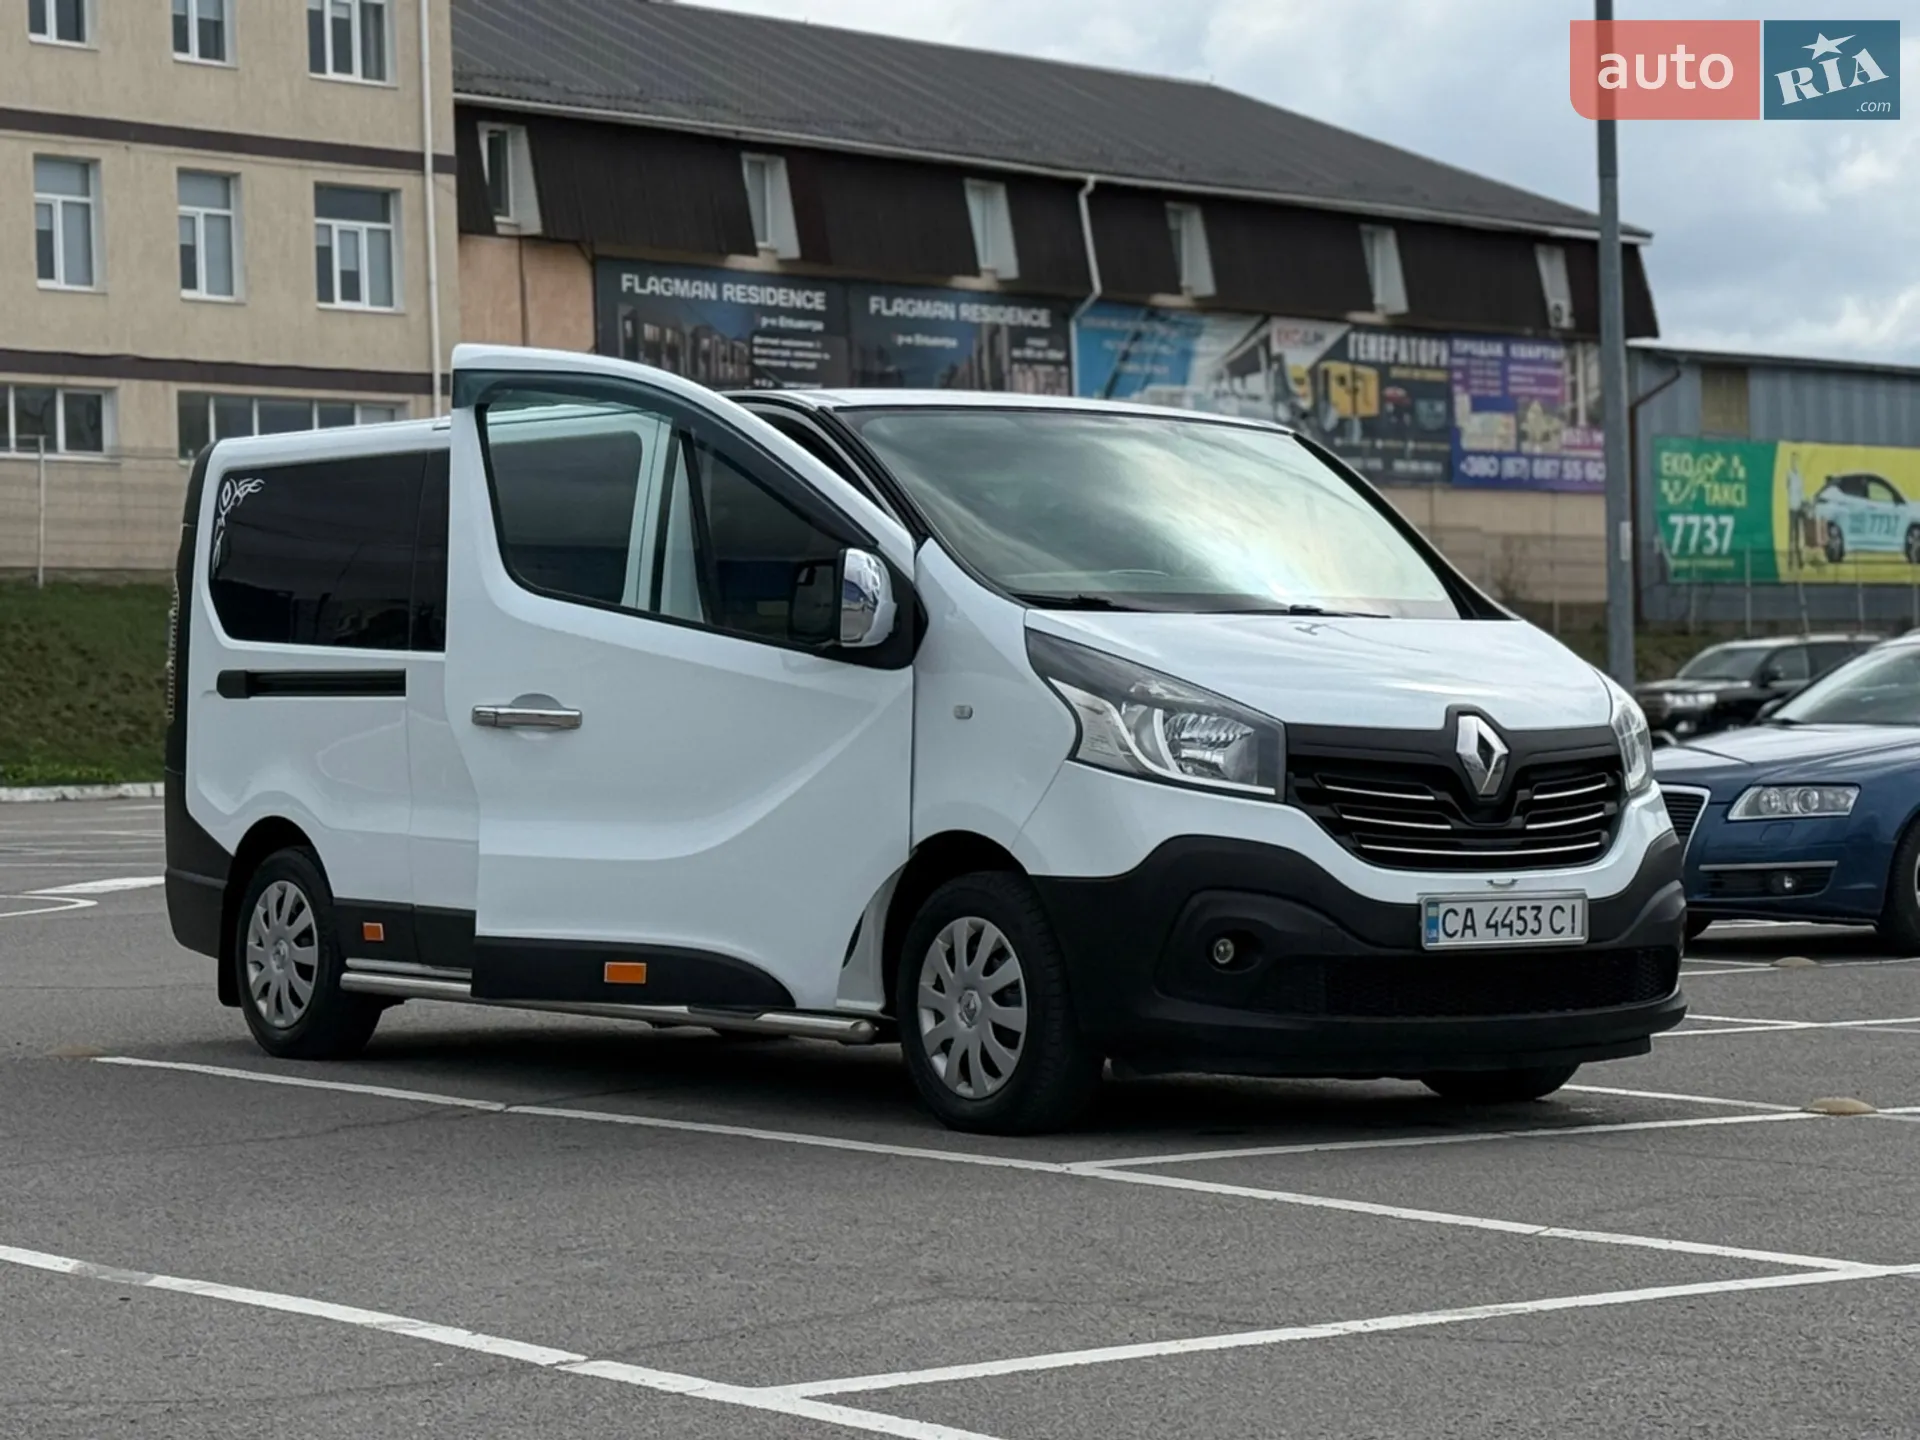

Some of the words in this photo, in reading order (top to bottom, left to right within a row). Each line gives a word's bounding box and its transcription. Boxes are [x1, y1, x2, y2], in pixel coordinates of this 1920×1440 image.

[621, 273, 717, 301] FLAGMAN
[722, 282, 827, 311] RESIDENCE
[869, 296, 956, 321] FLAGMAN
[959, 302, 1052, 328] RESIDENCE
[1459, 454, 1499, 478] +380
[1668, 513, 1735, 556] 7737
[1442, 907, 1477, 939] CA
[1485, 905, 1542, 937] 4453
[1549, 904, 1576, 935] CI
